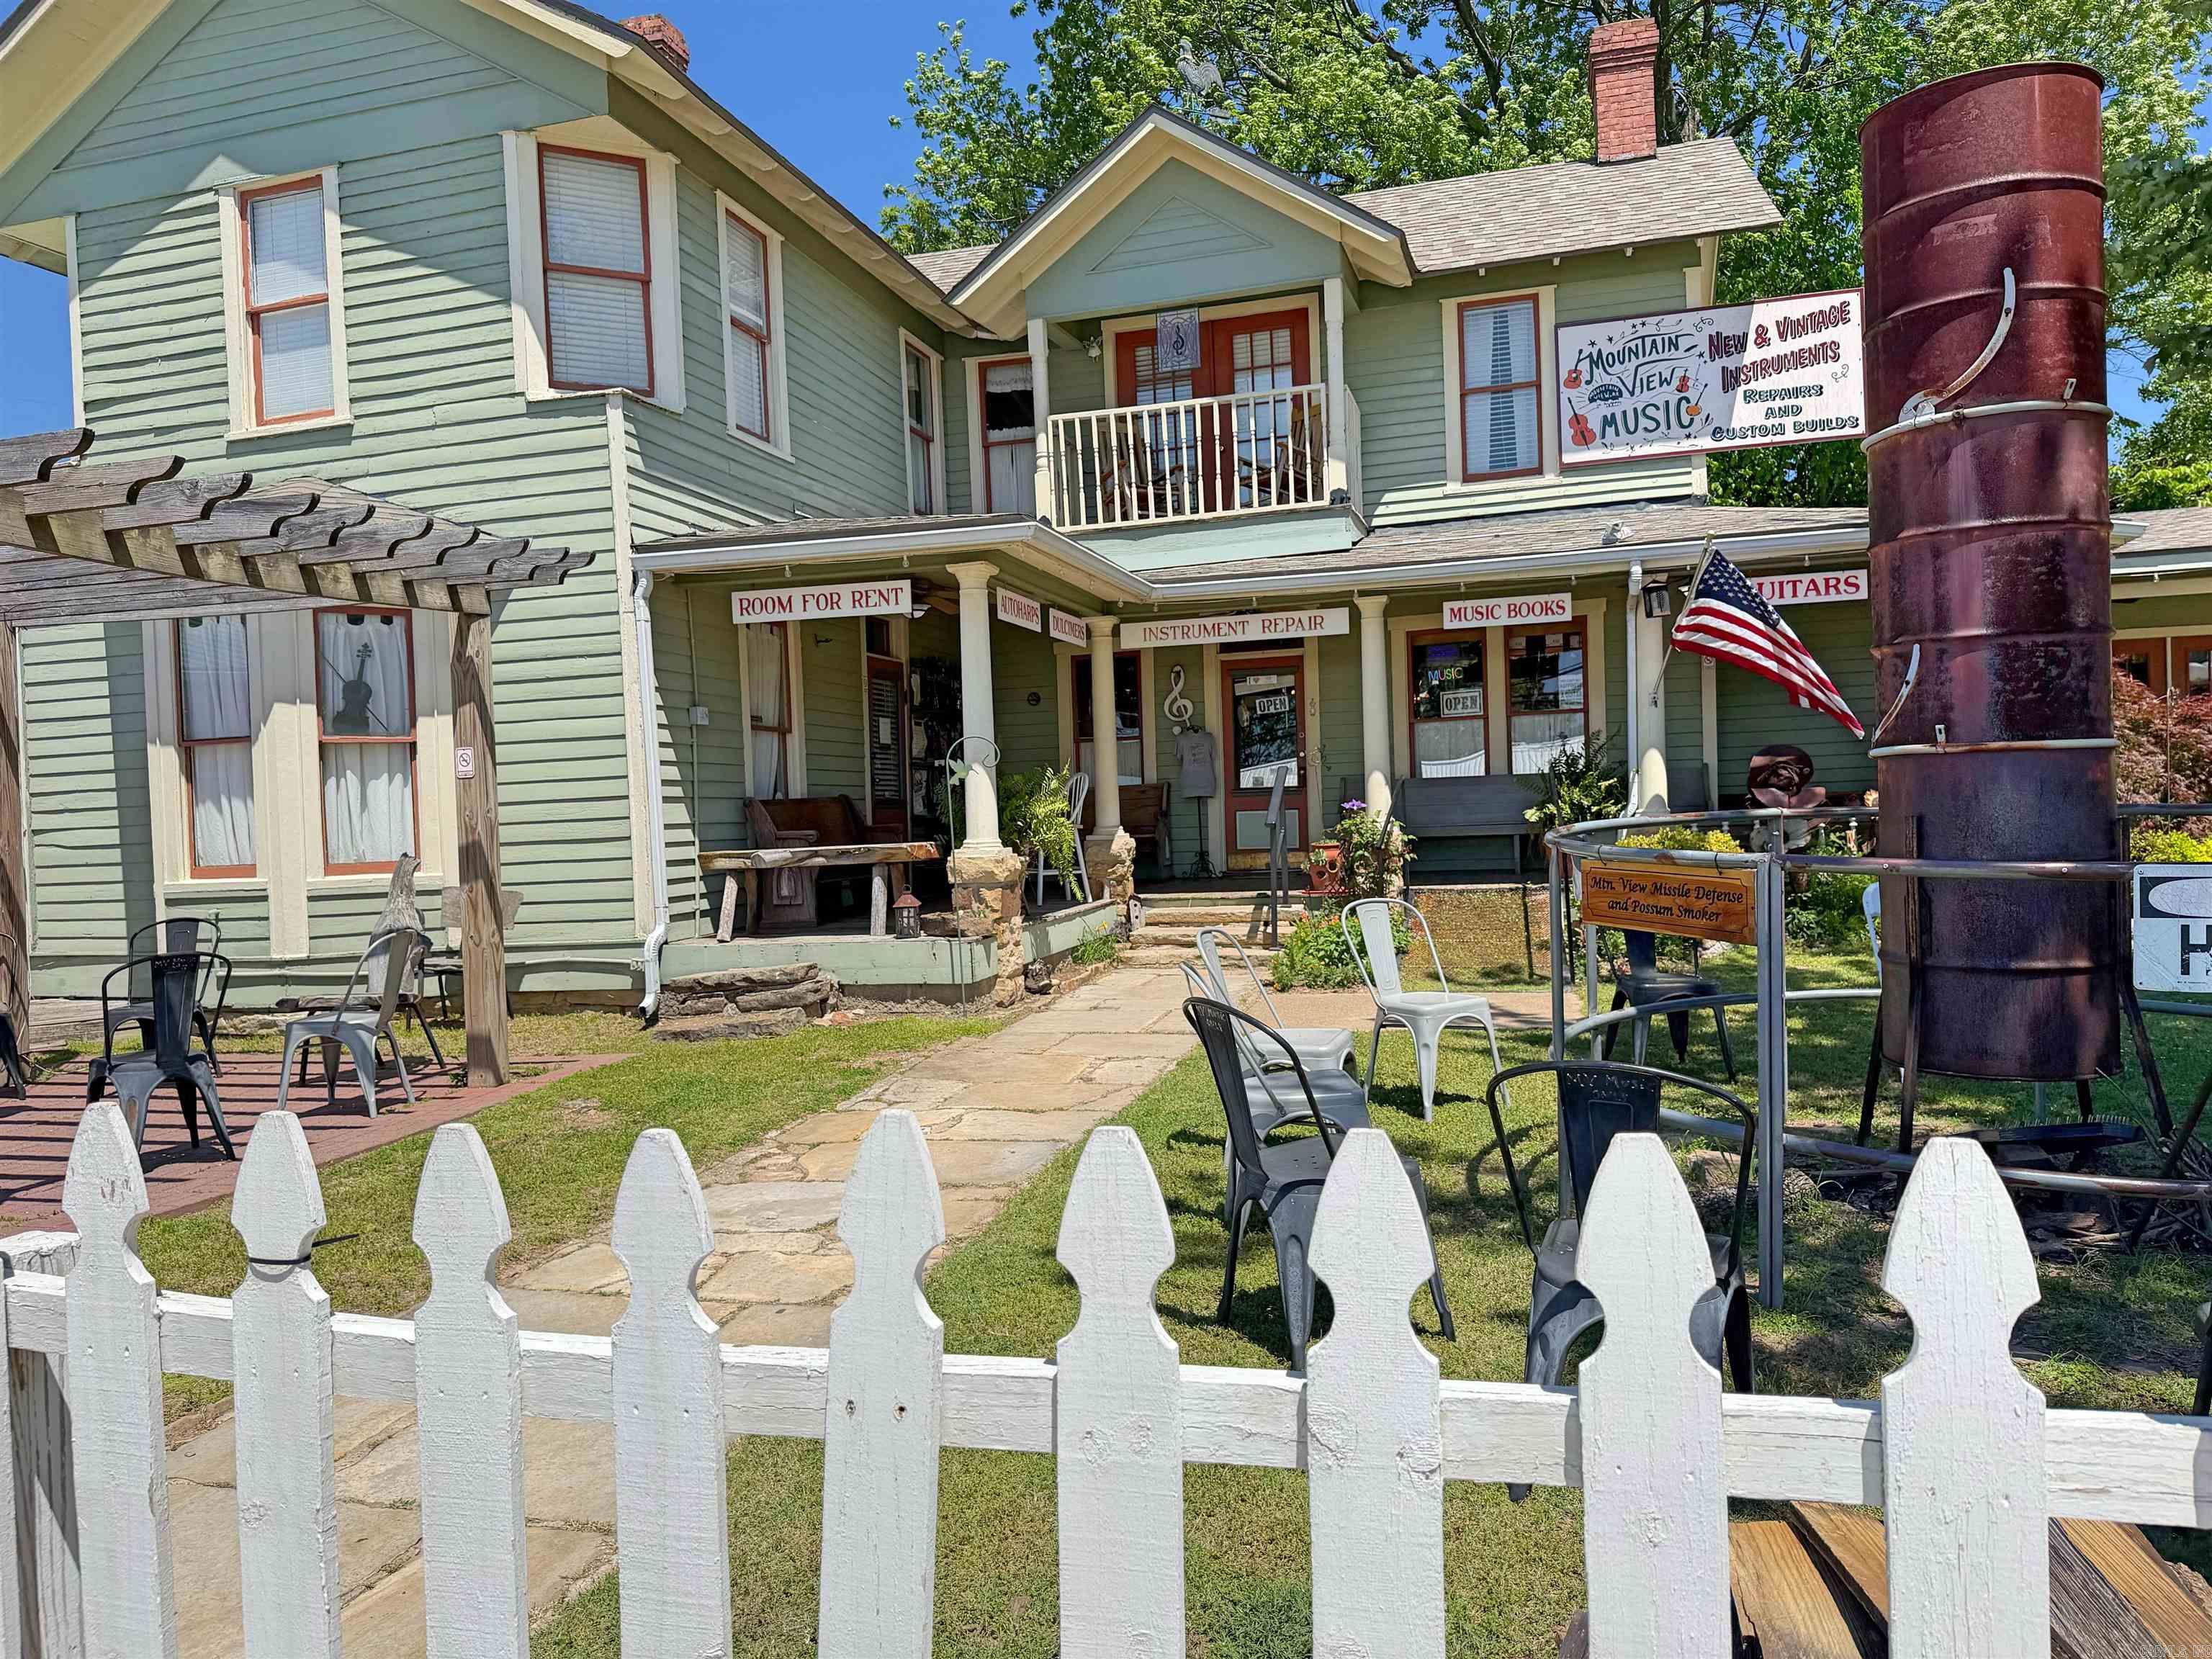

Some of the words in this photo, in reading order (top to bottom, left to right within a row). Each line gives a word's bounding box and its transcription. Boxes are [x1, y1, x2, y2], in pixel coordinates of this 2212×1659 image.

[1753, 323, 1771, 348] &
[1776, 300, 1851, 342] VINTAGE
[1581, 333, 1694, 385] MOUNTAIN
[1721, 340, 1840, 393] INSTRUMENTS
[1617, 355, 1692, 397] VIEW
[1743, 384, 1823, 403] REPAIRS
[1600, 396, 1694, 439] MUSIC
[1764, 404, 1802, 420] AND
[1711, 423, 1786, 442] CUSTOM
[1793, 415, 1859, 432] BUILDS
[1757, 575, 1861, 600] UITARS
[738, 595, 793, 617] ROOM
[802, 591, 842, 612] FOR
[851, 587, 904, 609] RENT
[1001, 595, 1040, 624] AUTOHARPS
[1449, 603, 1502, 623] MUSIC
[1506, 599, 1566, 619] BOOKS
[1053, 615, 1085, 640] DULCIMERS
[1143, 620, 1249, 642] INSTRUMENT
[1262, 614, 1325, 634] REPAIR
[1428, 667, 1464, 681] MUSIC
[1258, 697, 1287, 713] OPEN
[1445, 695, 1478, 711] OPEN
[1590, 877, 1616, 891] Mtn.
[1619, 877, 1647, 894] View
[1651, 881, 1691, 899] Missile
[1694, 886, 1744, 905] Defense
[1608, 896, 1629, 912] and
[1631, 900, 1674, 917] Possum
[1677, 905, 1722, 922] Smoker
